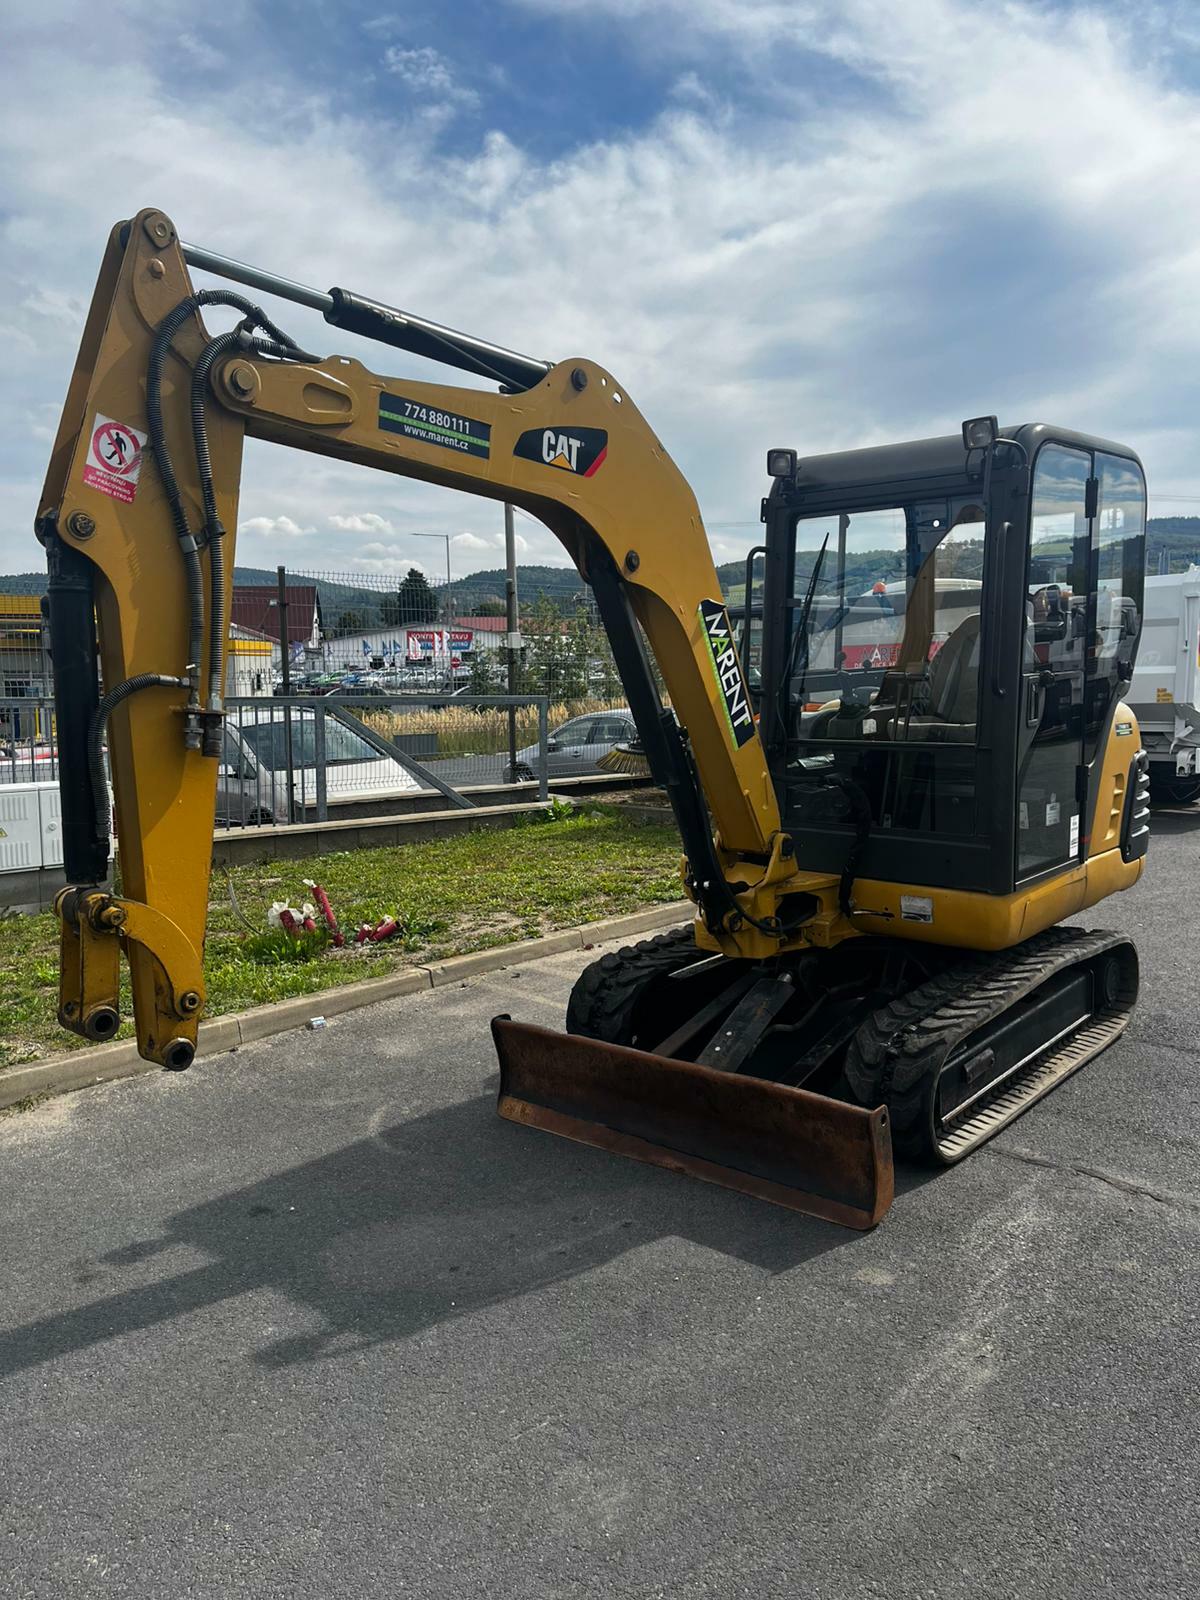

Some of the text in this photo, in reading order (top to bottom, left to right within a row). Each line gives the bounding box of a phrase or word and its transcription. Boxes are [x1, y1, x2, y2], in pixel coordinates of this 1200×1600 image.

[404, 402, 427, 422] 774
[404, 424, 469, 450] www.marent.cz
[542, 430, 581, 471] CAT
